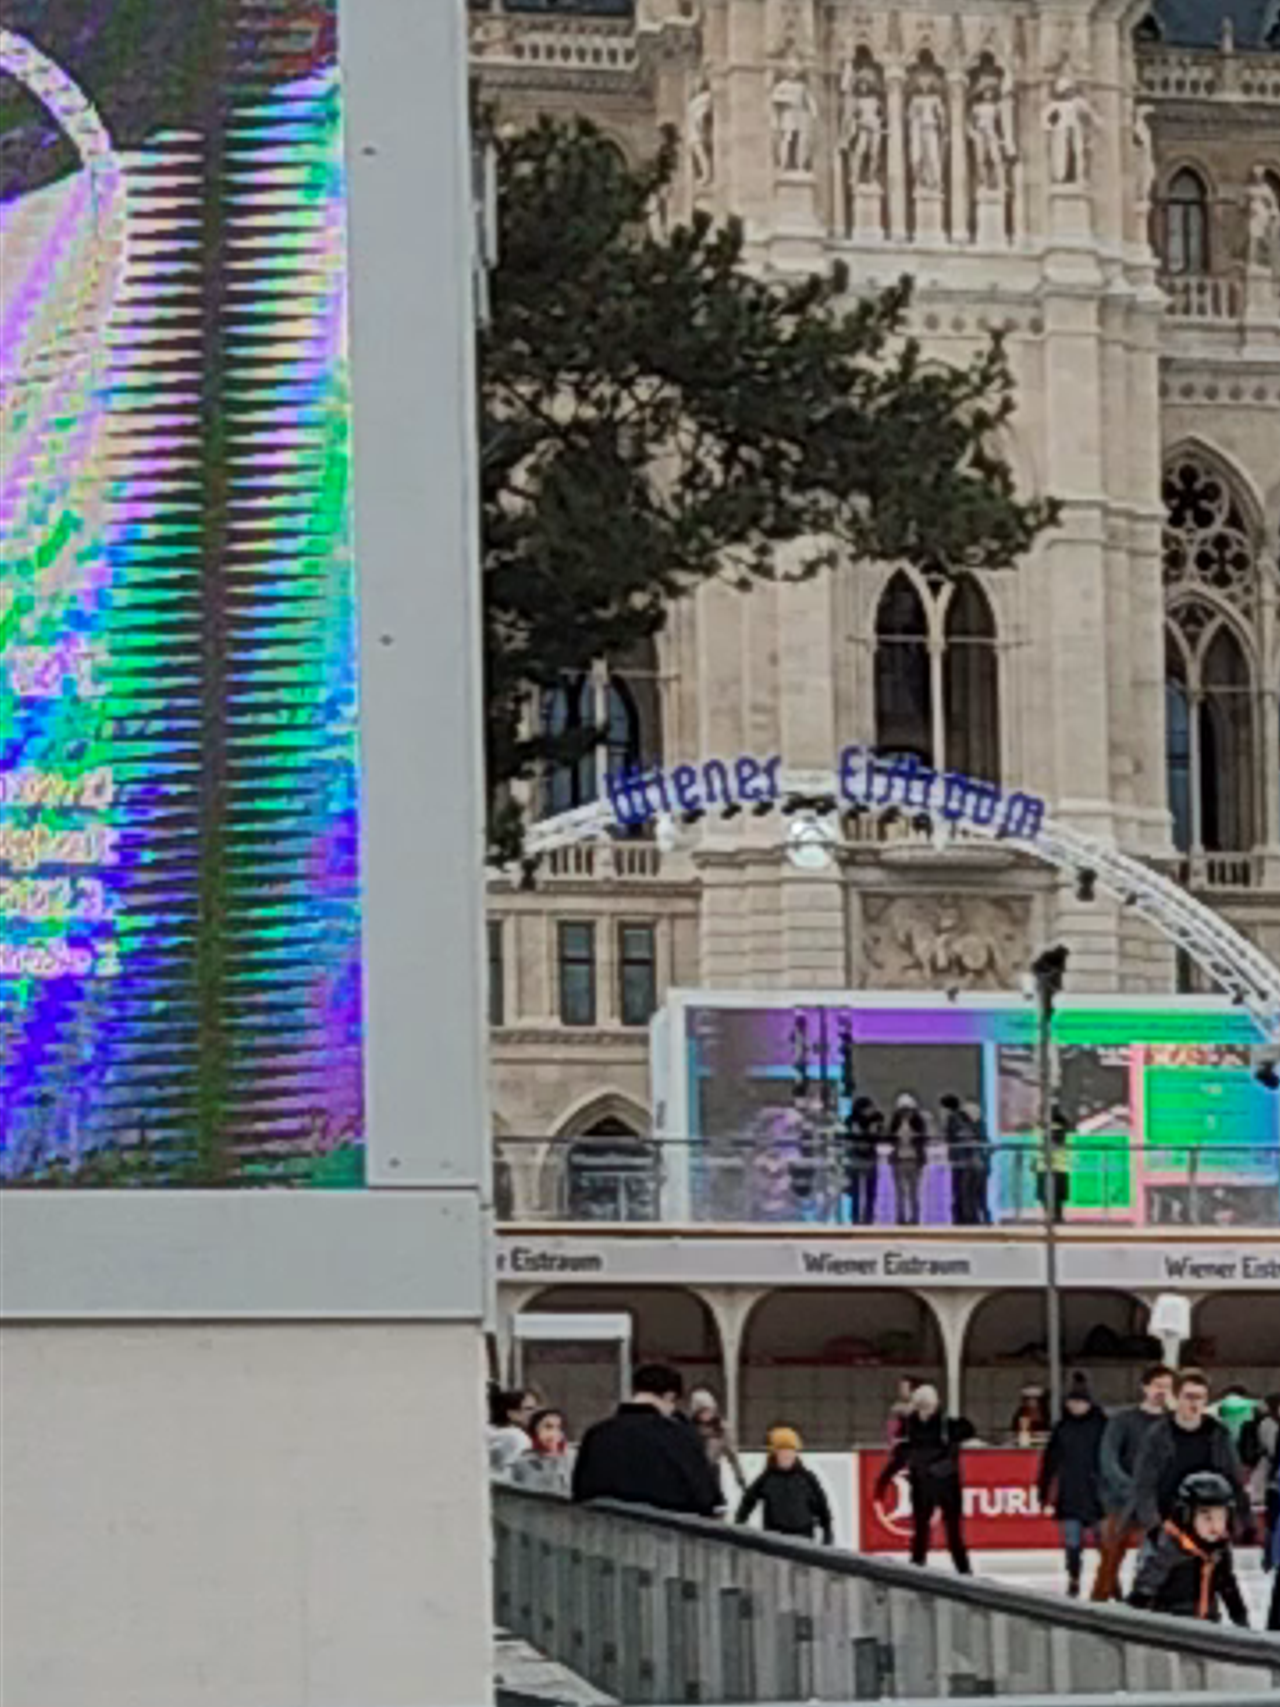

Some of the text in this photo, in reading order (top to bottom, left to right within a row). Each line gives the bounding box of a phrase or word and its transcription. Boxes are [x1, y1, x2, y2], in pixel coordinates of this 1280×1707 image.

[604, 754, 784, 826] Wiener
[510, 1248, 603, 1272] Eistraum
[803, 1253, 971, 1276] Wiener Eistraum
[1164, 1256, 1237, 1280] Wiener
